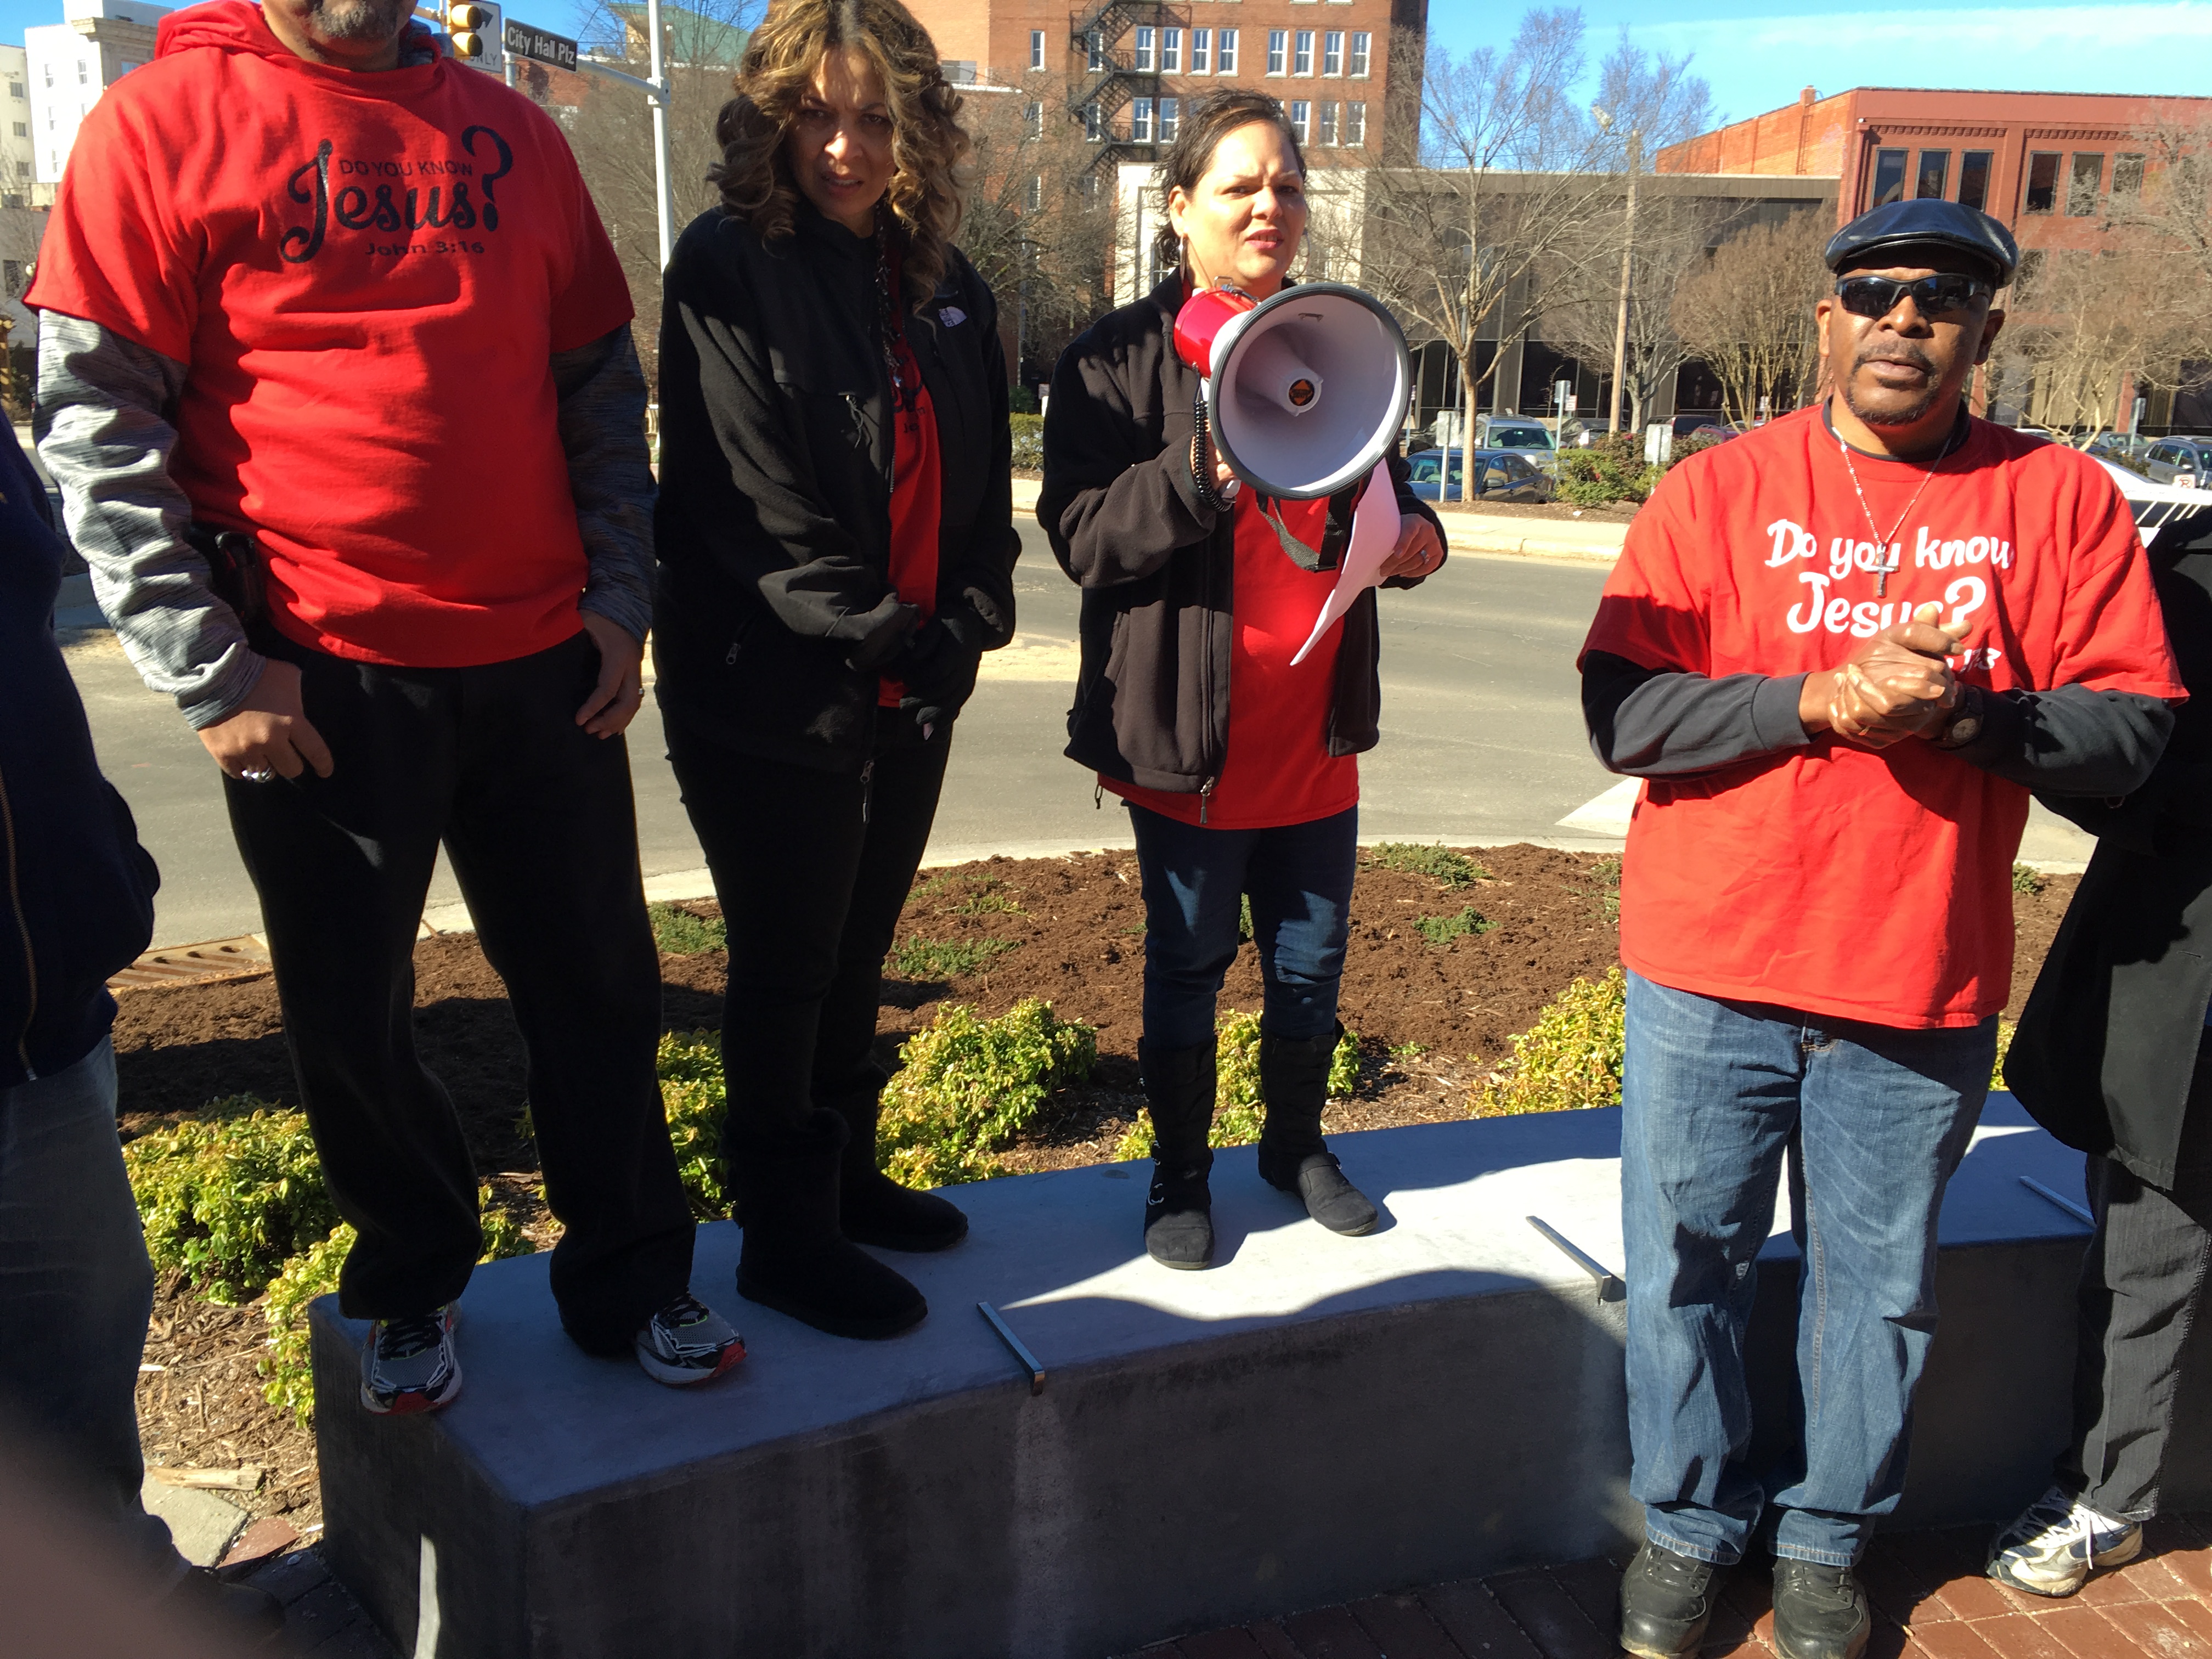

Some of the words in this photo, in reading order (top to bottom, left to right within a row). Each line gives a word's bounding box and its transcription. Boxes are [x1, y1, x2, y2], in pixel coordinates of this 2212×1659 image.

[470, 52, 498, 66] NLY
[507, 26, 531, 55] City
[534, 35, 555, 59] Hall
[558, 42, 575, 65] Plz
[340, 160, 369, 176] DO
[370, 161, 412, 177] YOU
[419, 160, 472, 176] KNOW
[280, 125, 514, 263] Jesus?
[365, 242, 427, 256] John
[1764, 519, 1817, 567] Do
[1829, 538, 1901, 579] you
[1915, 526, 2015, 569] know
